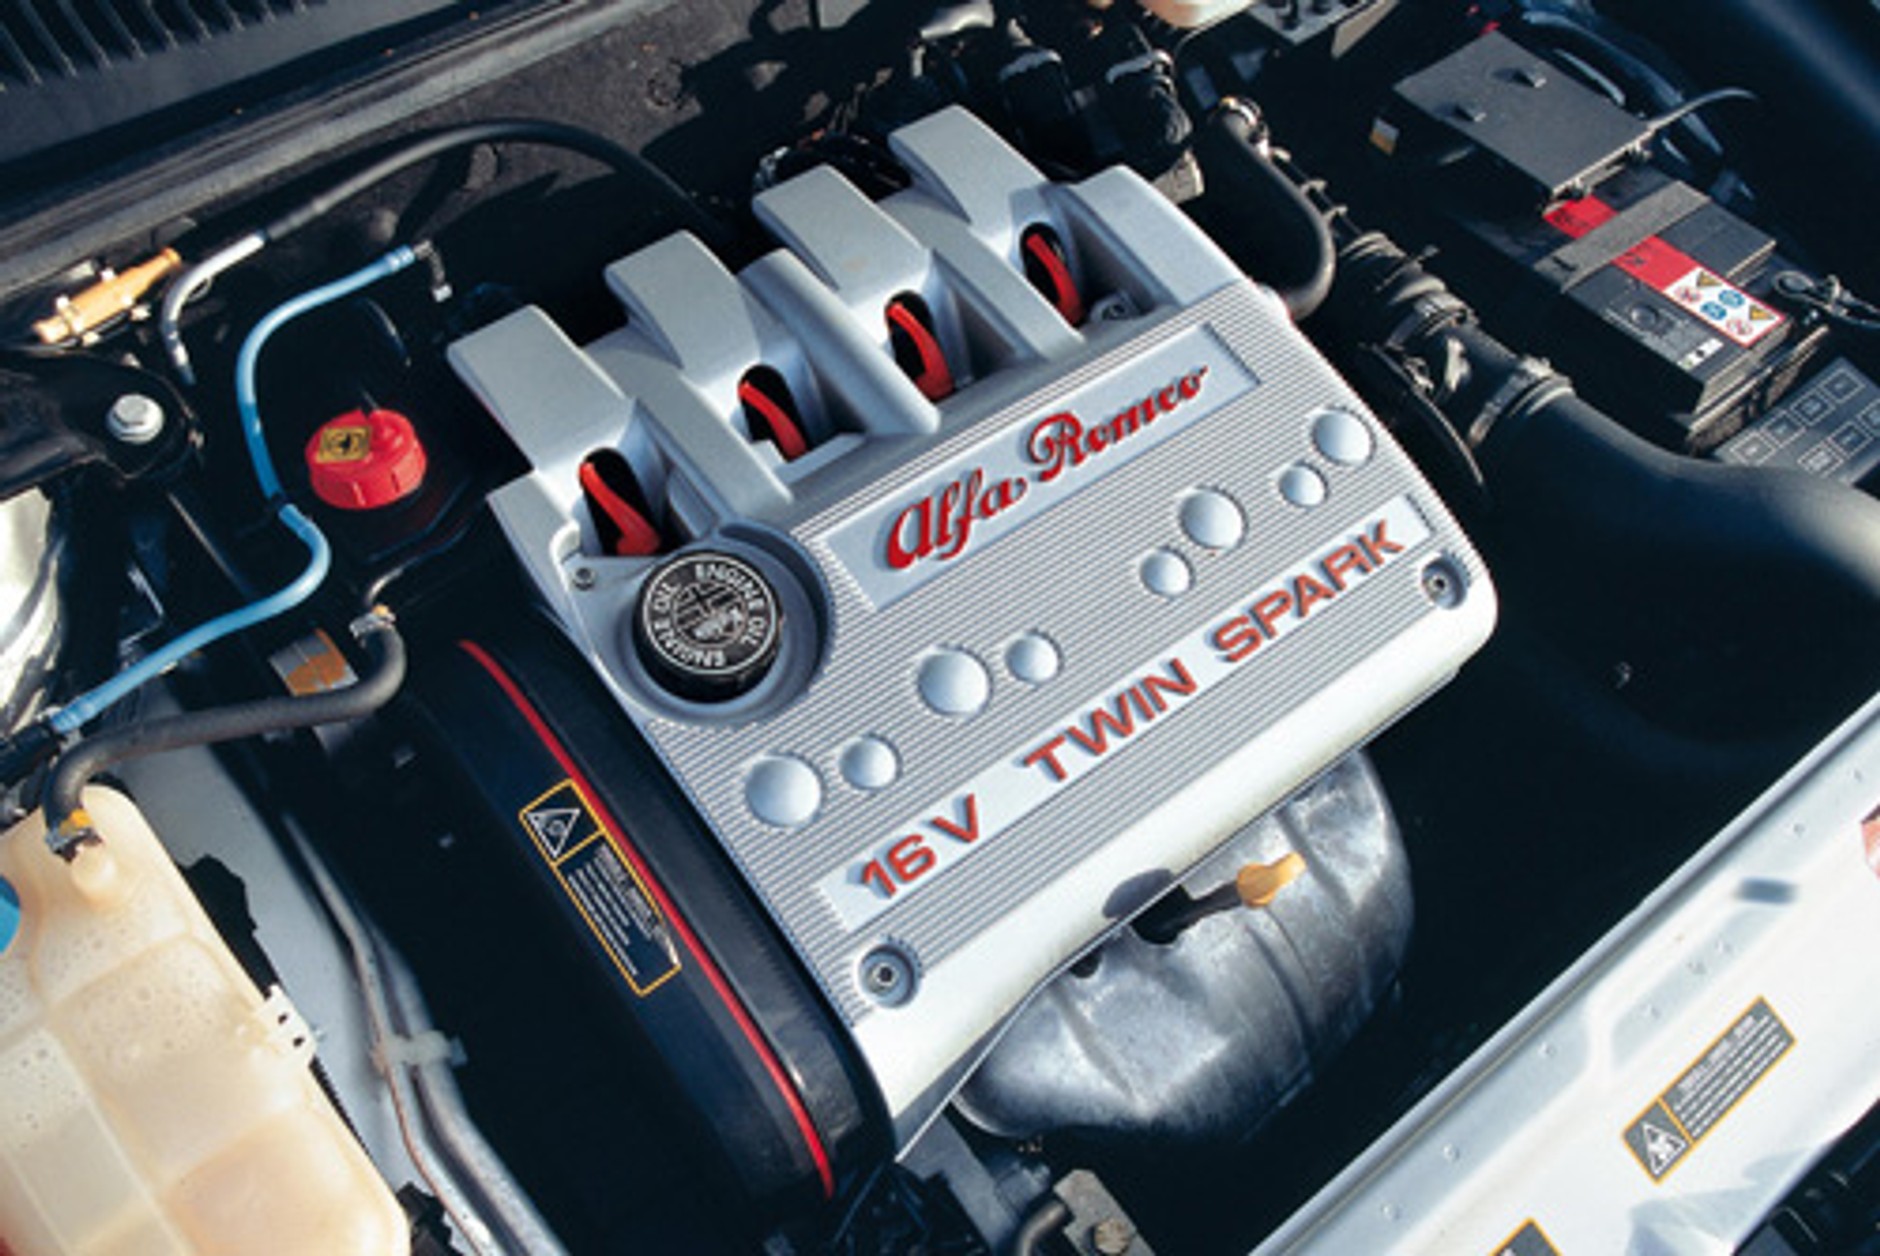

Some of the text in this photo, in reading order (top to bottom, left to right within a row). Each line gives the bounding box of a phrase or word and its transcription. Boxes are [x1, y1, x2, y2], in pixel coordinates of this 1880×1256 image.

[887, 366, 1208, 571] Alfa Romeo
[653, 581, 728, 667] ENGINE OIL
[694, 563, 768, 647] ENGINE OIL
[1025, 658, 1198, 781] TWIN
[1216, 521, 1404, 662] SPARK
